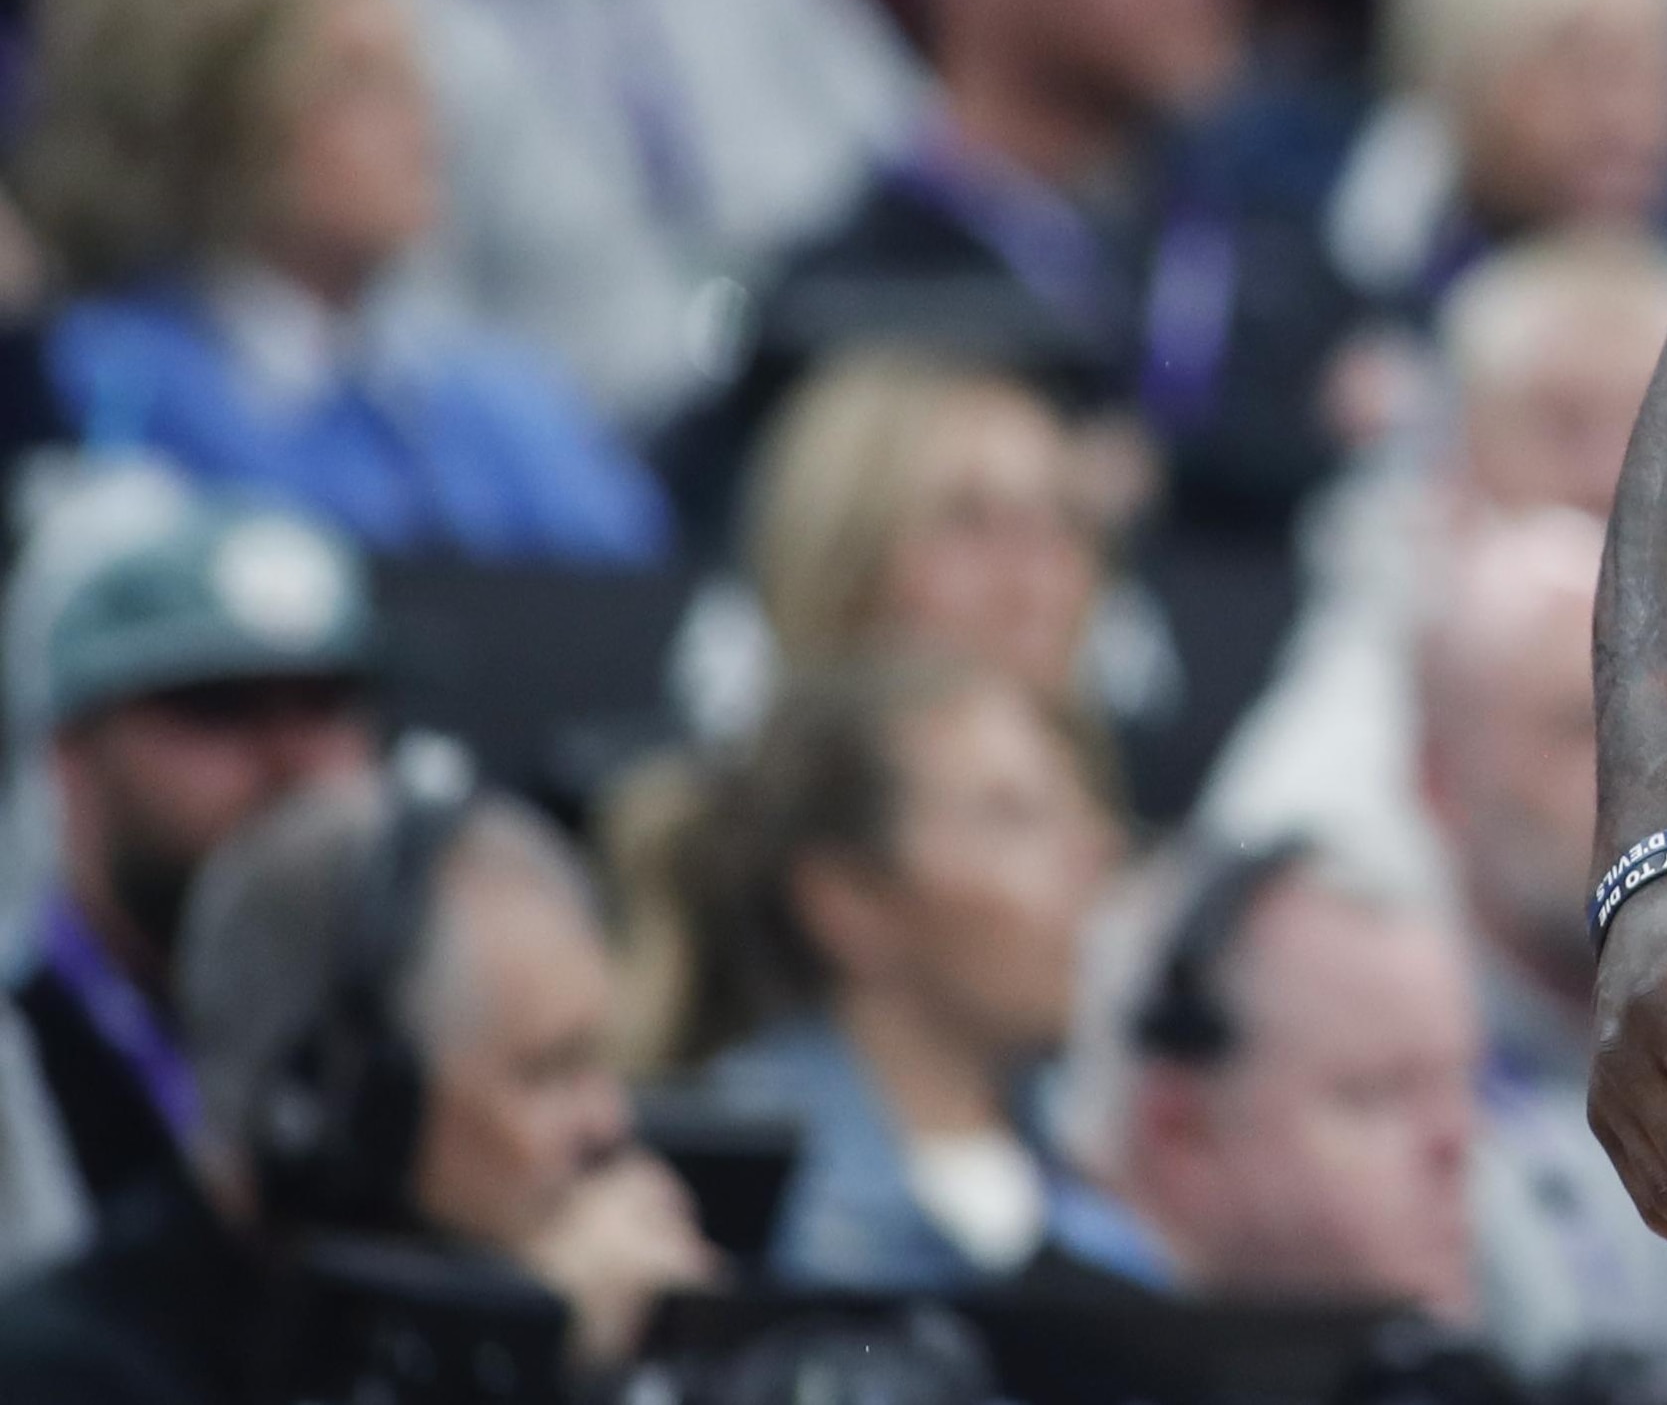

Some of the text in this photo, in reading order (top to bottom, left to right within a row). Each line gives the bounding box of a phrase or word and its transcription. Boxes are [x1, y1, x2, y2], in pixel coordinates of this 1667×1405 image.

[1595, 831, 1666, 902] D'EVILS
[1625, 862, 1657, 890] TO
[1597, 886, 1622, 928] DIE
